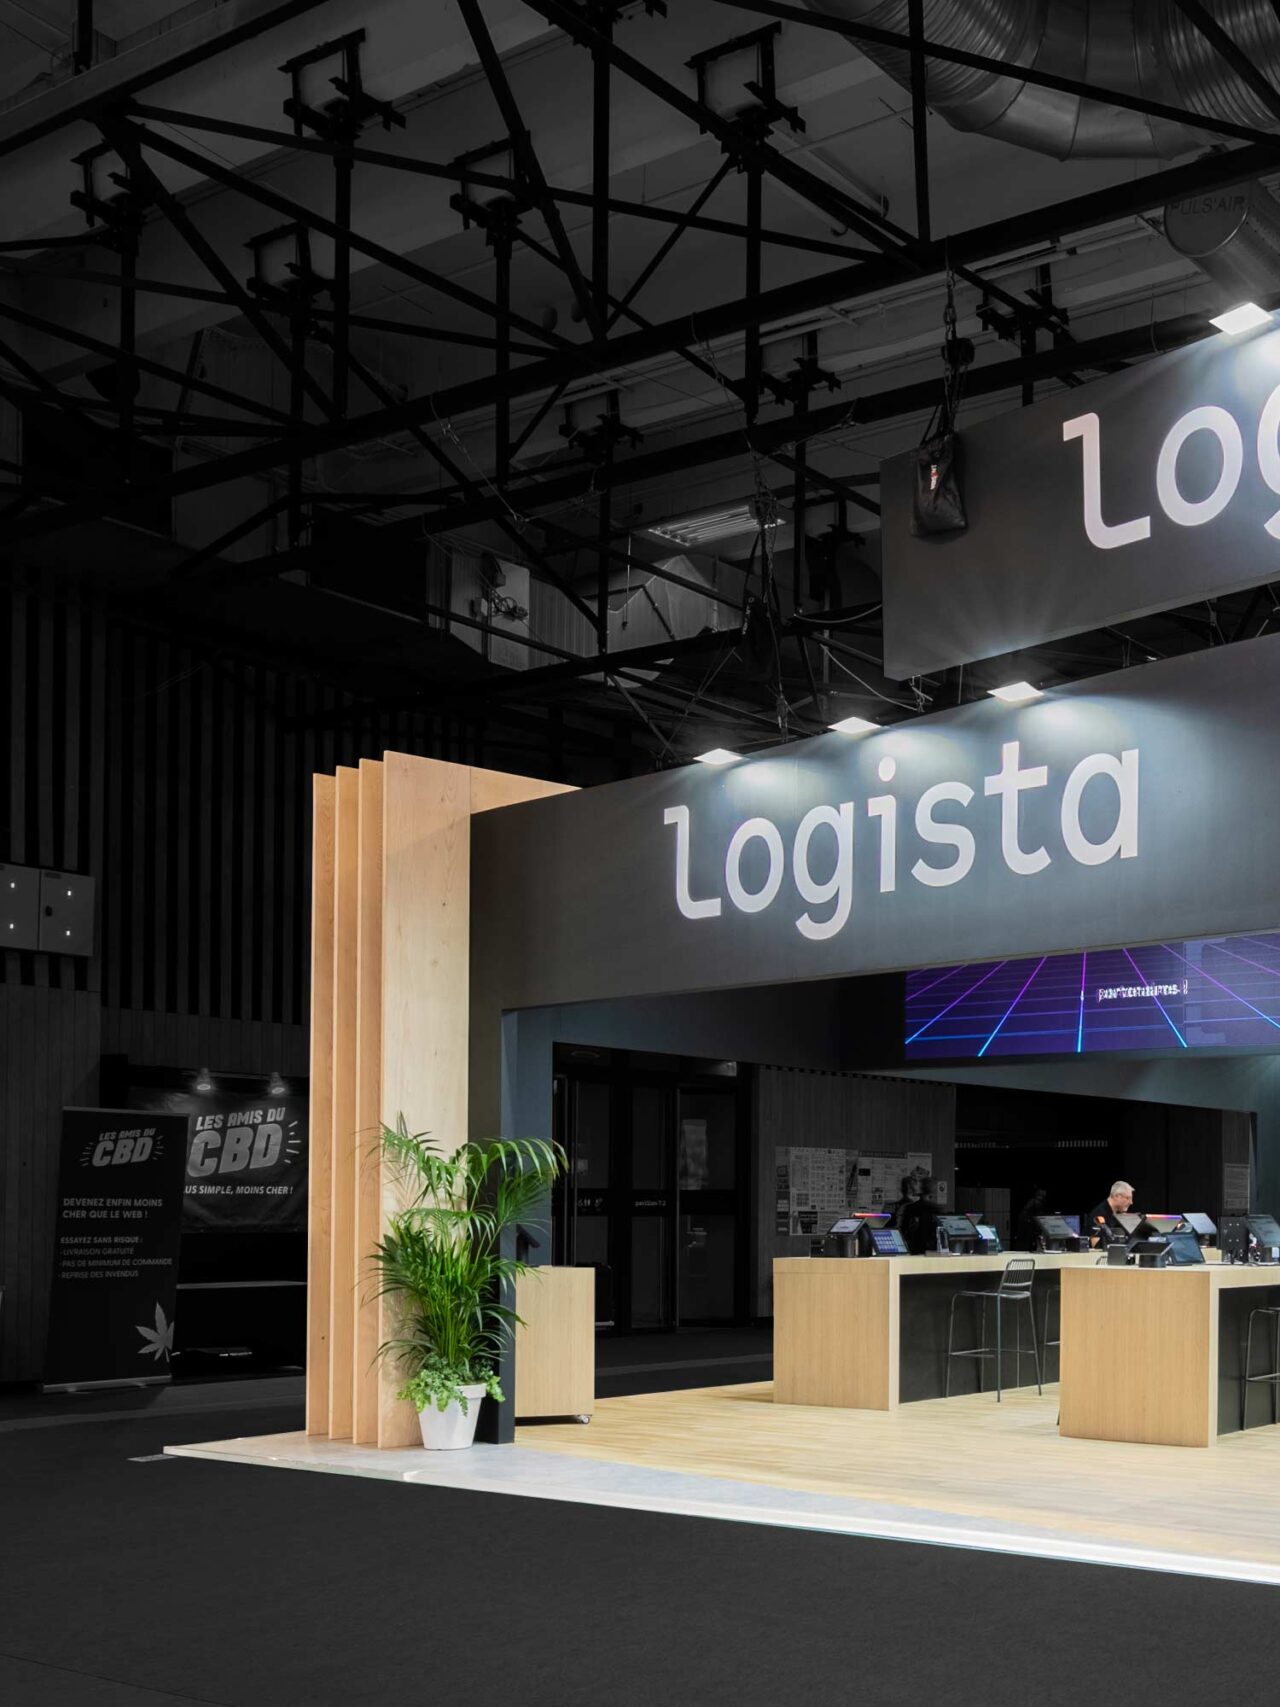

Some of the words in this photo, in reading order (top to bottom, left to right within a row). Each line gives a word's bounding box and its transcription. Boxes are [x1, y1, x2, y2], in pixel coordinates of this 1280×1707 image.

[196, 1114, 224, 1131] LES
[227, 1110, 263, 1127] AMIS
[266, 1107, 286, 1123] DU
[99, 1131, 117, 1141] LES
[118, 1129, 142, 1139] AMIS
[143, 1127, 157, 1137] DU
[92, 1136, 154, 1167] CBD
[187, 1123, 283, 1178] CBD
[198, 1185, 234, 1196] SIMPLE,
[235, 1186, 264, 1195] MOINS
[266, 1186, 289, 1195] CHER
[63, 1198, 105, 1207] DEVENEZ
[106, 1198, 132, 1207] ENFIN
[133, 1198, 163, 1207] MOINS
[62, 1210, 87, 1219] CHER
[89, 1210, 108, 1219] QUE
[110, 1210, 120, 1219] LE
[122, 1210, 143, 1219] WEB
[60, 1236, 92, 1244] ESSAYEZ
[93, 1236, 112, 1244] SANS
